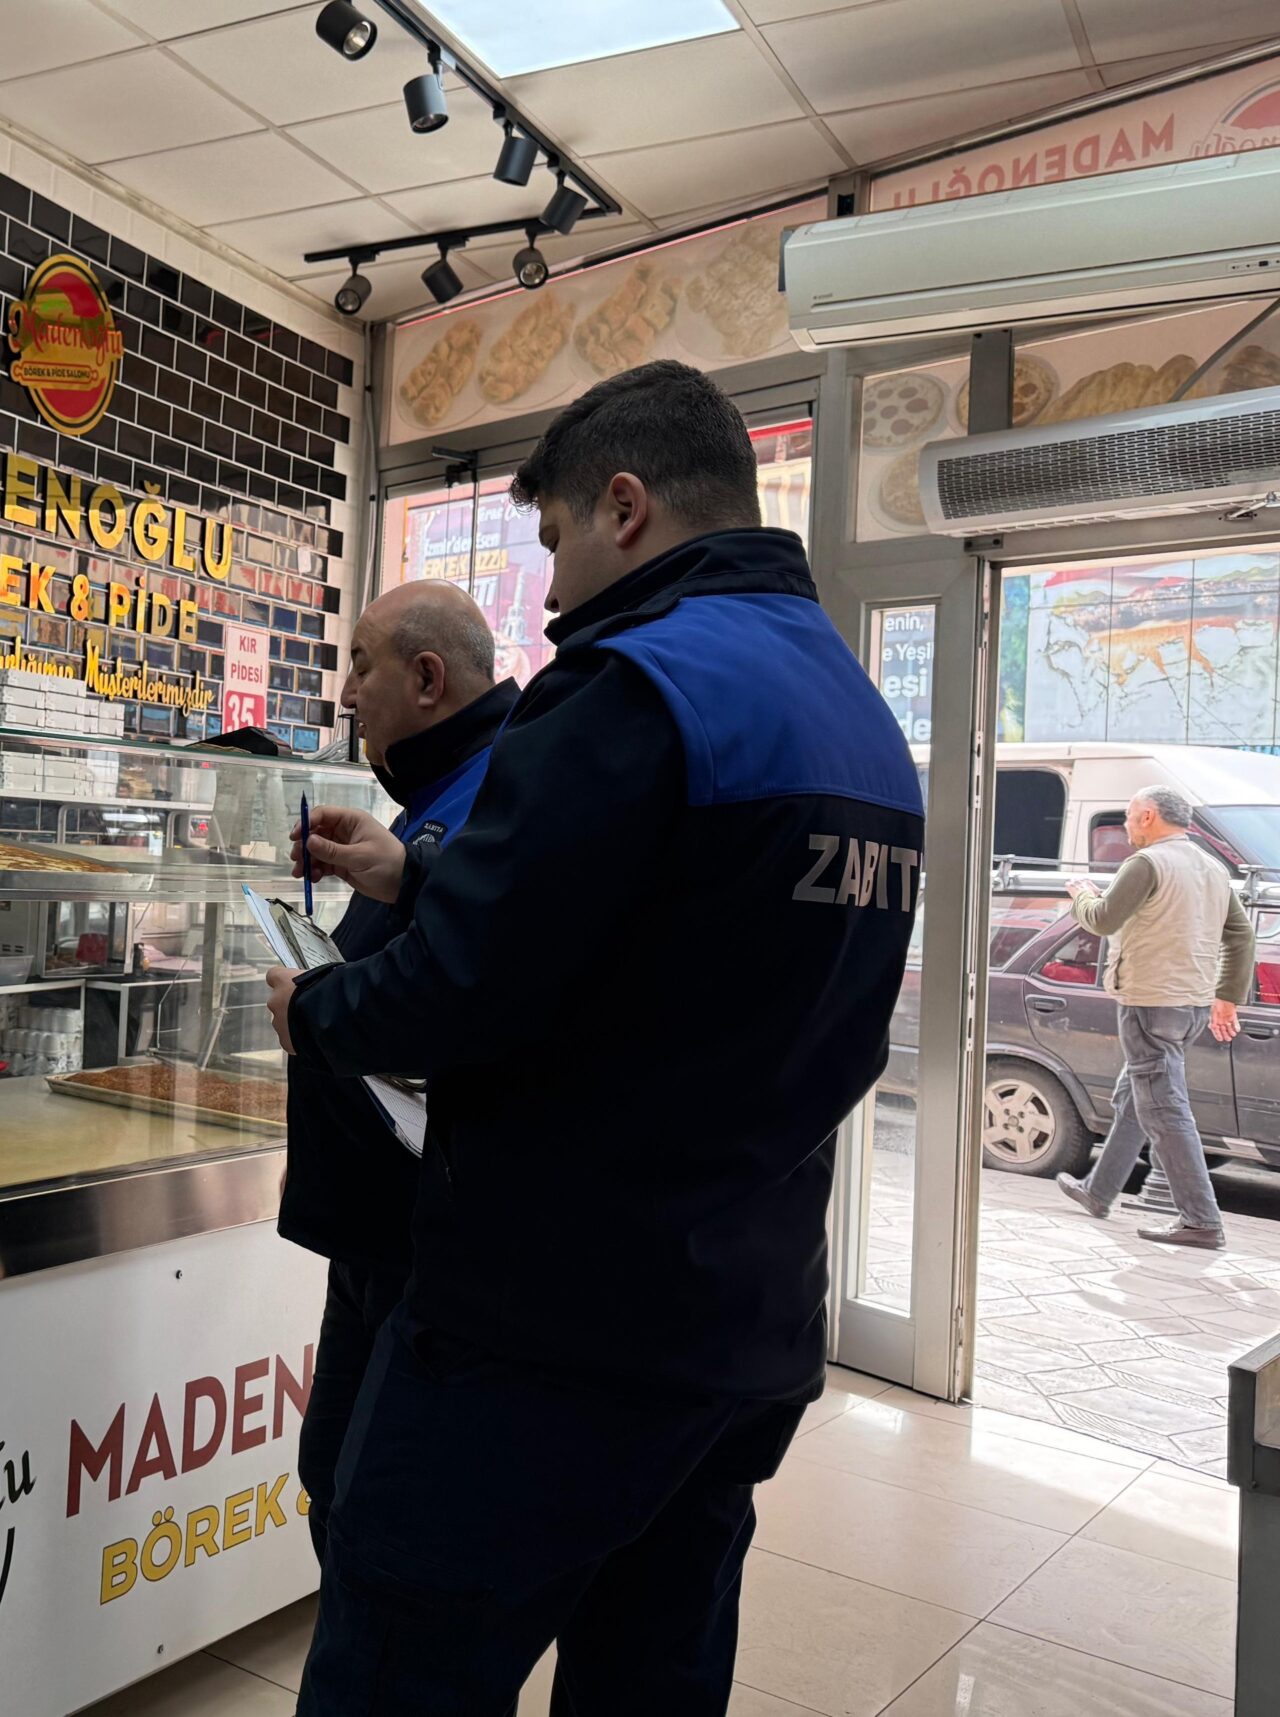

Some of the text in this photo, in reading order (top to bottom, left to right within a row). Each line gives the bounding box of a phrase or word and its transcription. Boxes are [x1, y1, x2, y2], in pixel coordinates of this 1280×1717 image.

[23, 366, 46, 377] BÖREK
[52, 367, 67, 378] PİDE
[71, 574, 90, 621] &
[109, 576, 199, 643] PİDE
[85, 638, 217, 718] Müşterilerimizdir
[230, 660, 263, 683] PİDESİ
[239, 635, 257, 654] KIR
[227, 694, 256, 733] 35
[792, 834, 917, 912] ZABIT
[66, 1343, 314, 1518] MADEN
[100, 1473, 291, 1605] BÖREK
